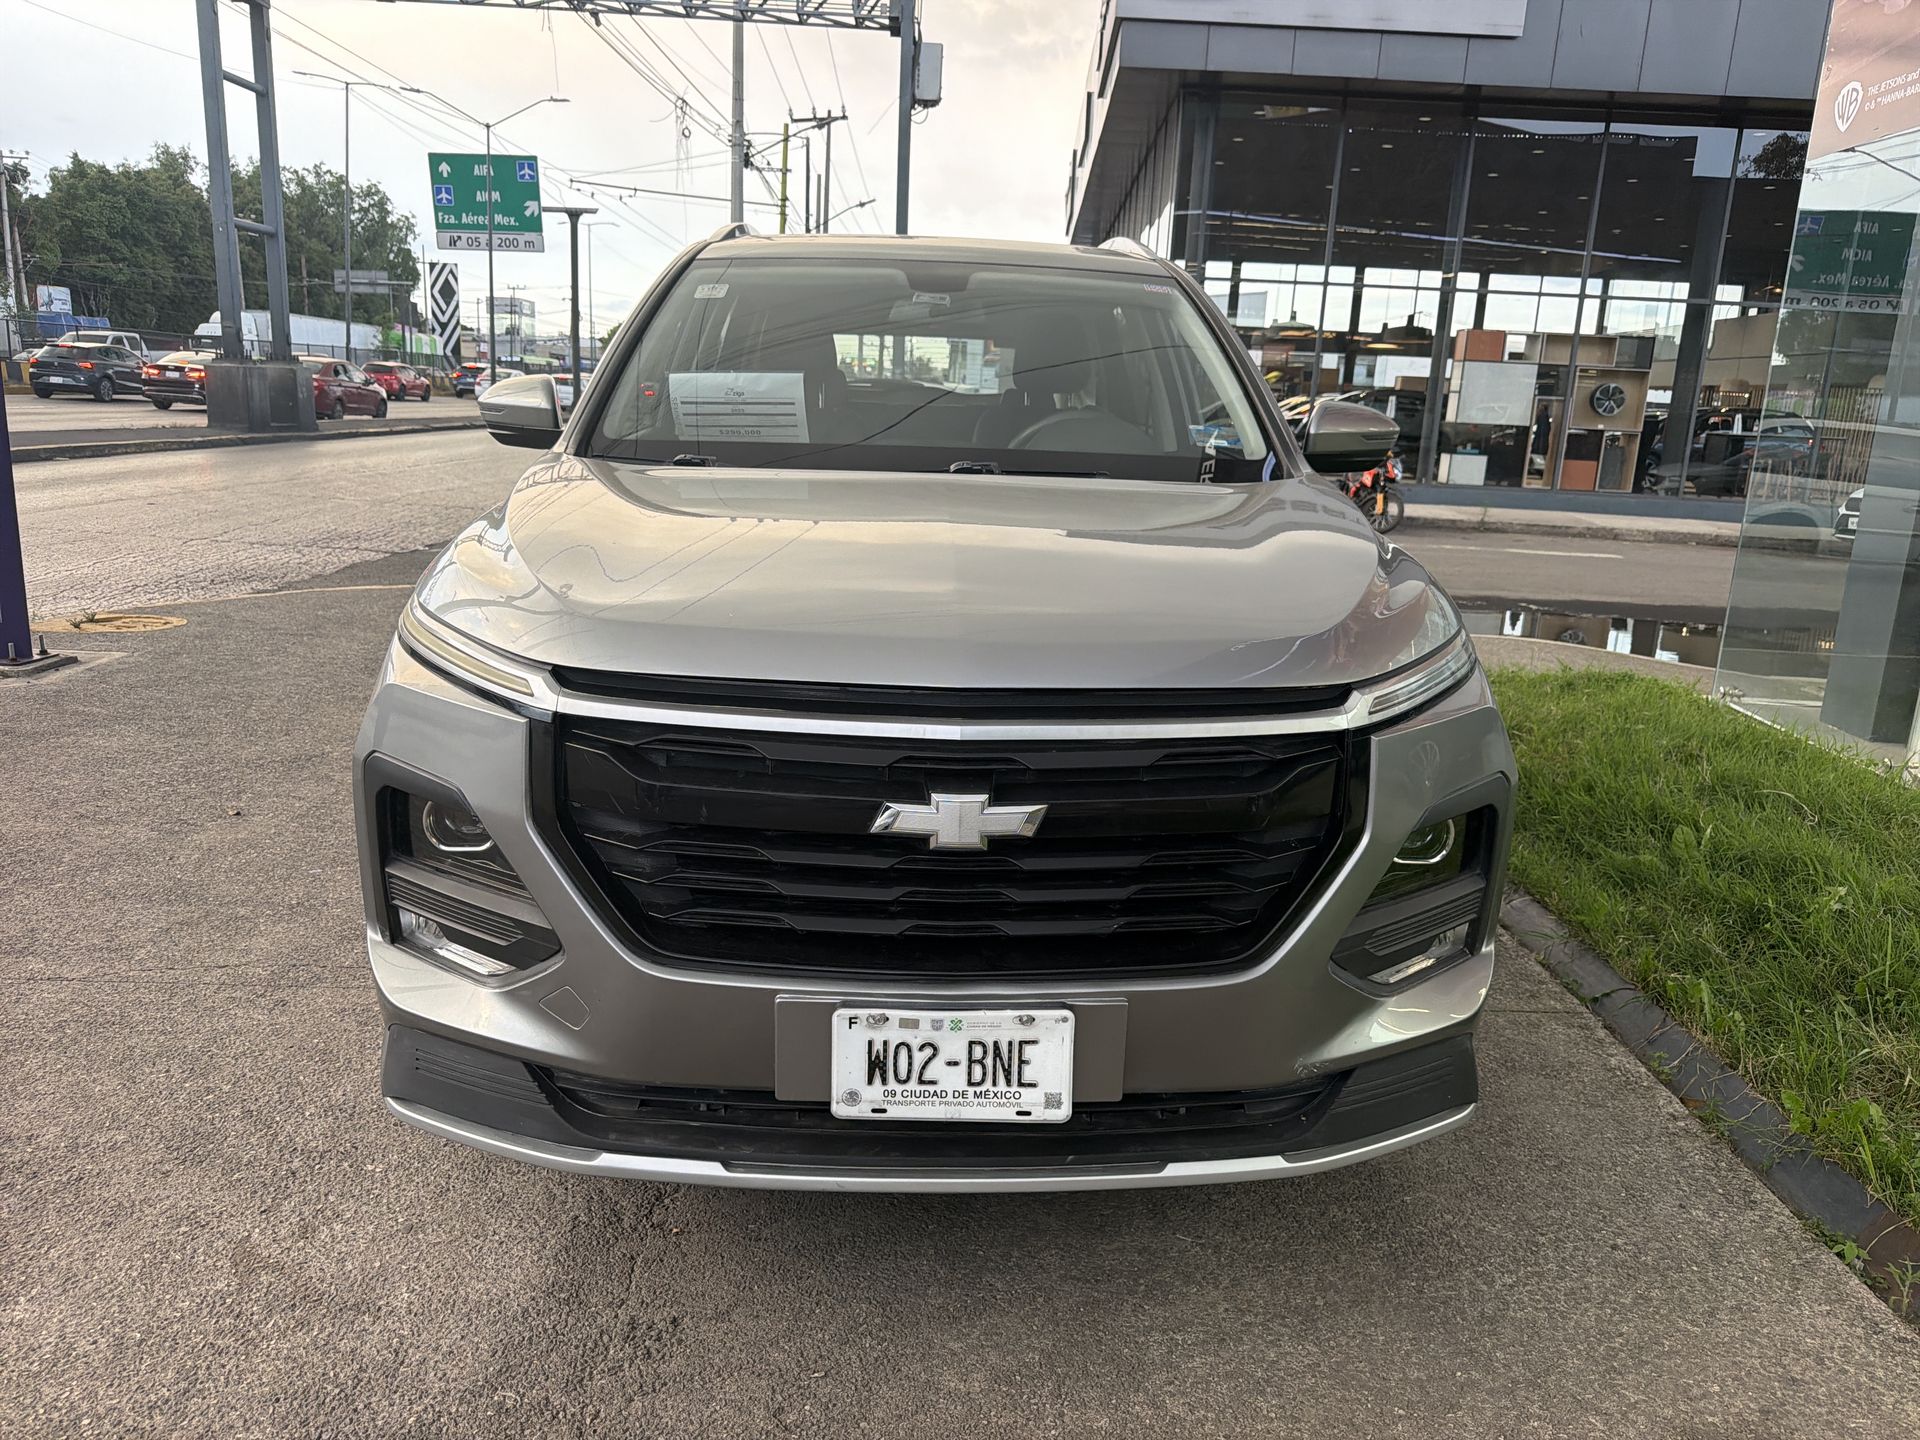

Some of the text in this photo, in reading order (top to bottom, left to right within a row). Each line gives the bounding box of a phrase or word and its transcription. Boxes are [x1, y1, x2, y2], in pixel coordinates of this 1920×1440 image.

[1867, 83, 1881, 97] THE
[438, 212, 458, 224] Fza.
[494, 213, 519, 226] Mex.
[466, 236, 481, 248] 05
[496, 237, 519, 249] 200
[524, 240, 535, 249] m
[849, 1017, 858, 1029] F
[865, 1038, 1040, 1088] W02-BNE
[883, 1087, 1022, 1101] 09 CIUDAD DE MÉXICO
[881, 1099, 1024, 1109] TRANSPORTE PRIVADO AUTOMÓVIL
